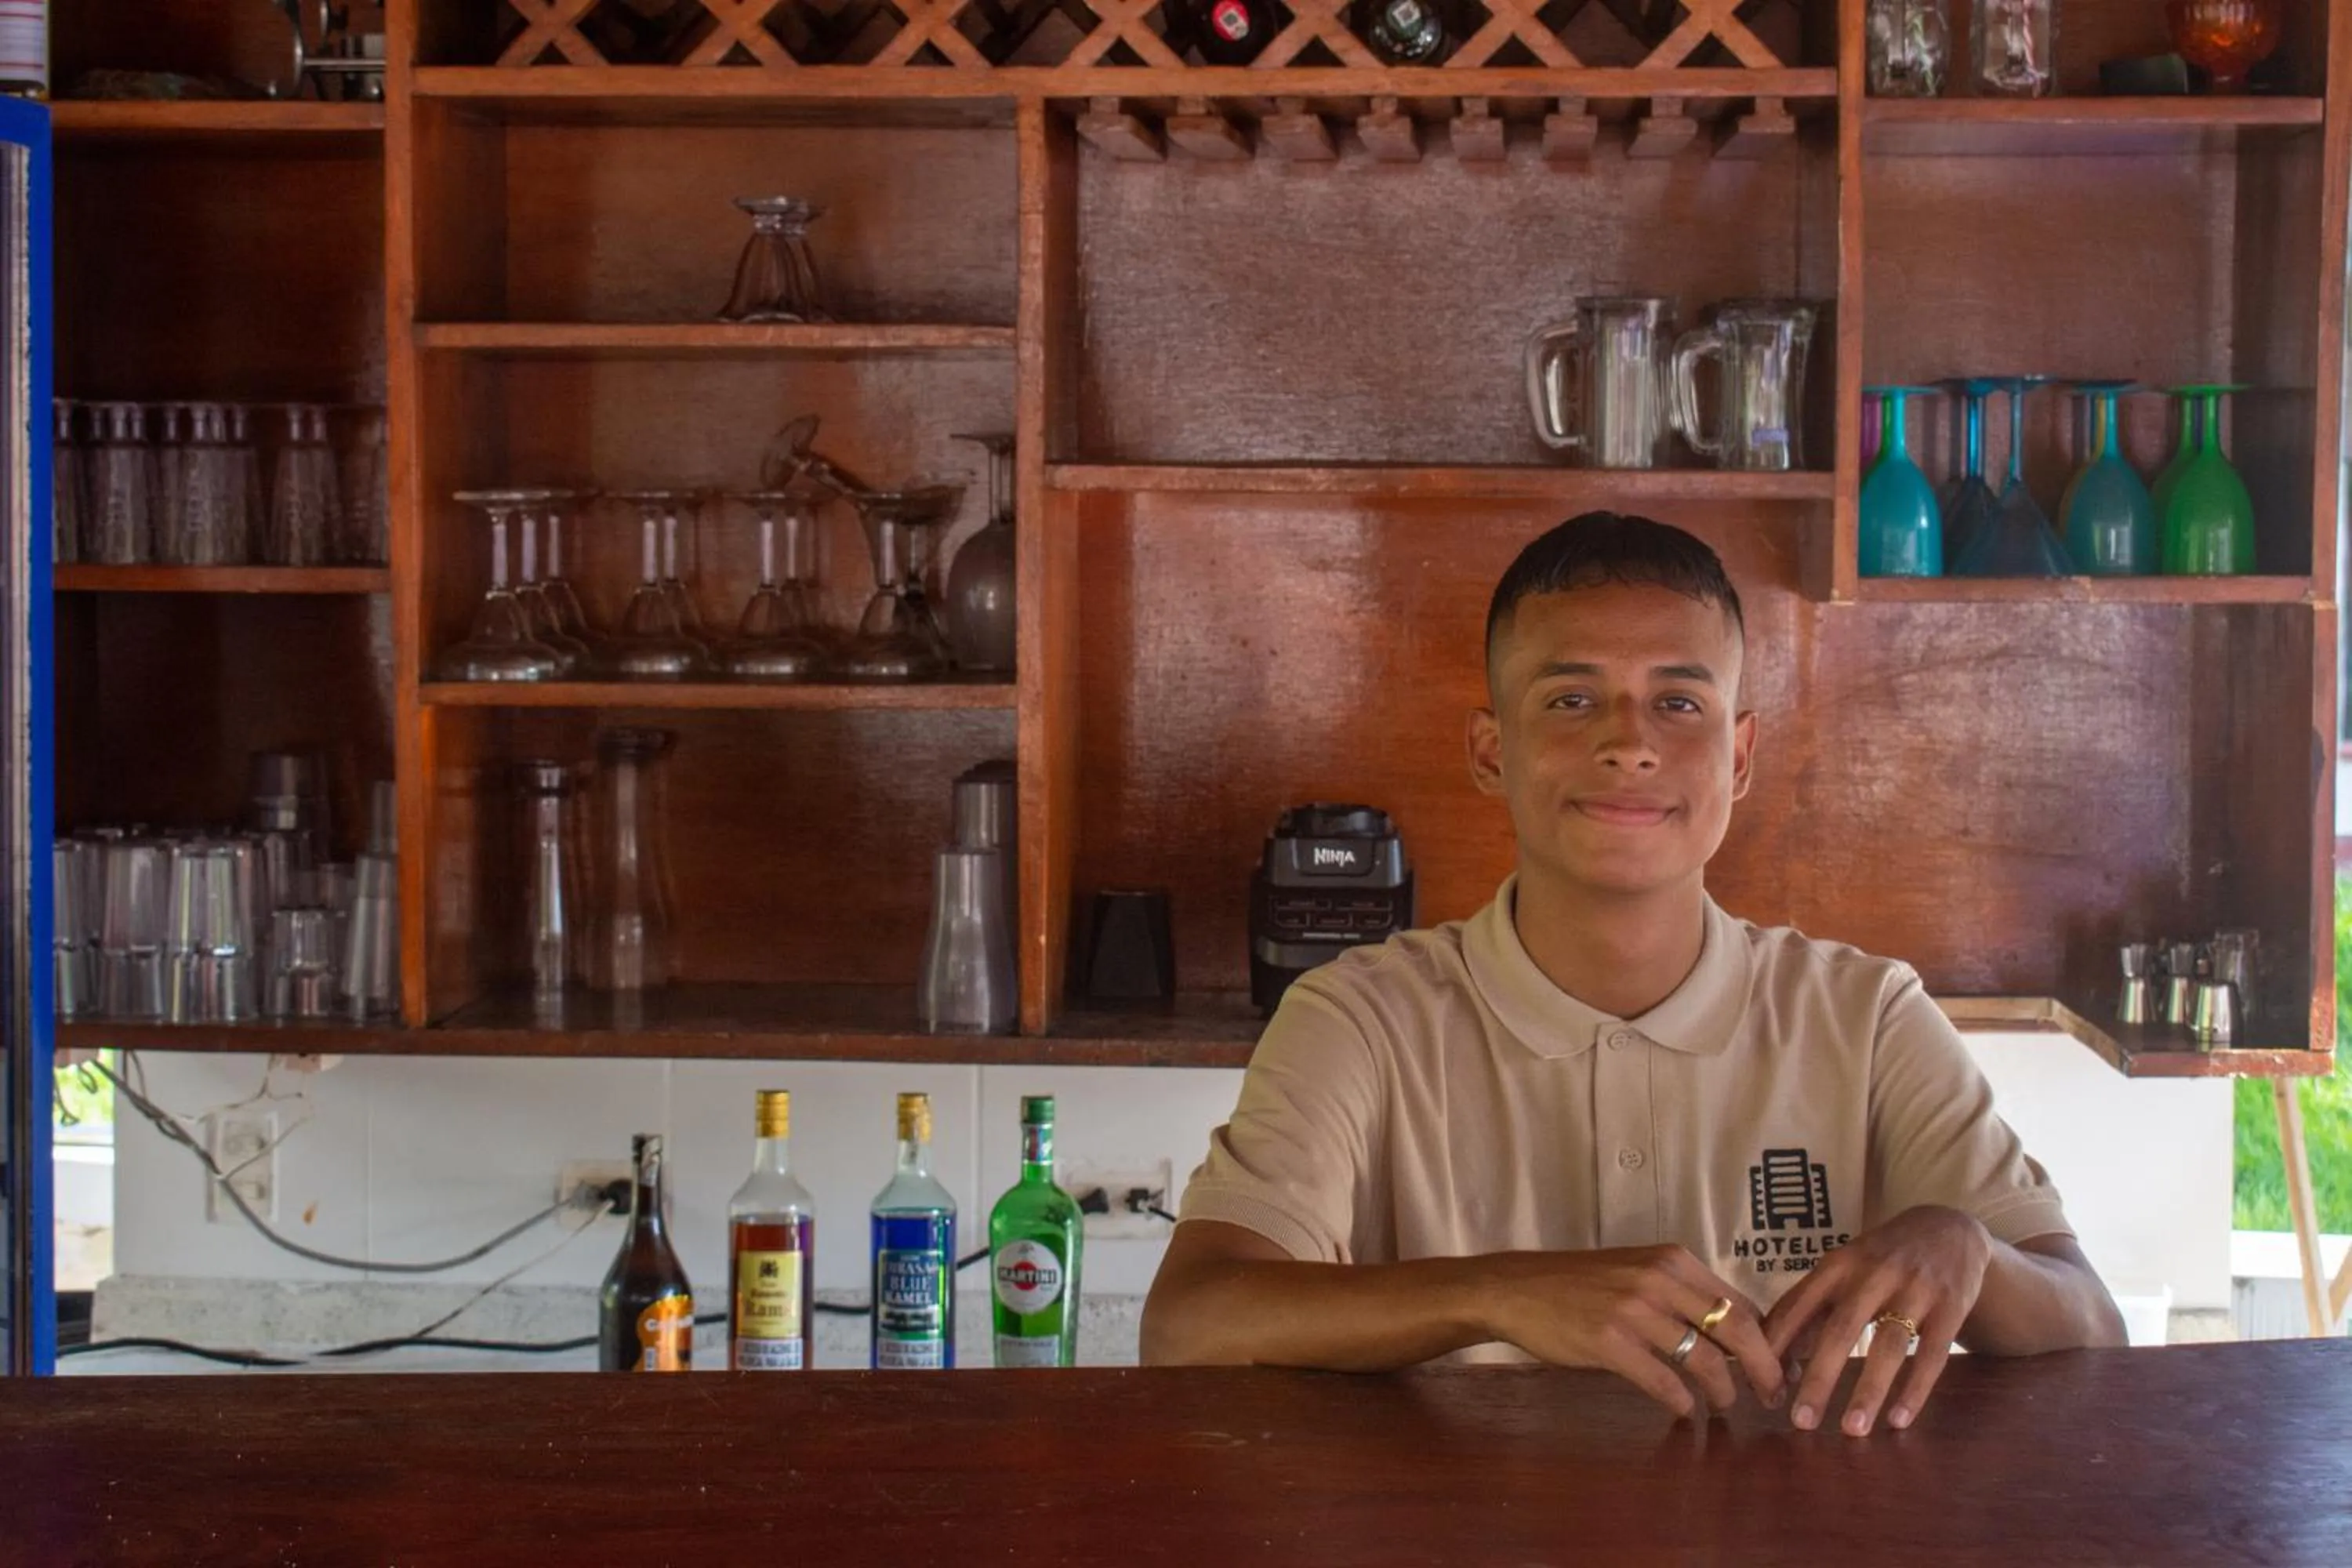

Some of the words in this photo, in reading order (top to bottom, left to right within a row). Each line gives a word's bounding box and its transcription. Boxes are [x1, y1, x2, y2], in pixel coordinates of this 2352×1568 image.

[1313, 847, 1356, 868] NINJA
[1733, 1233, 1850, 1257] HOTELES
[1755, 1258, 1776, 1272] BY
[890, 1275, 931, 1291] BLUE
[997, 1267, 1058, 1284] MARTINI
